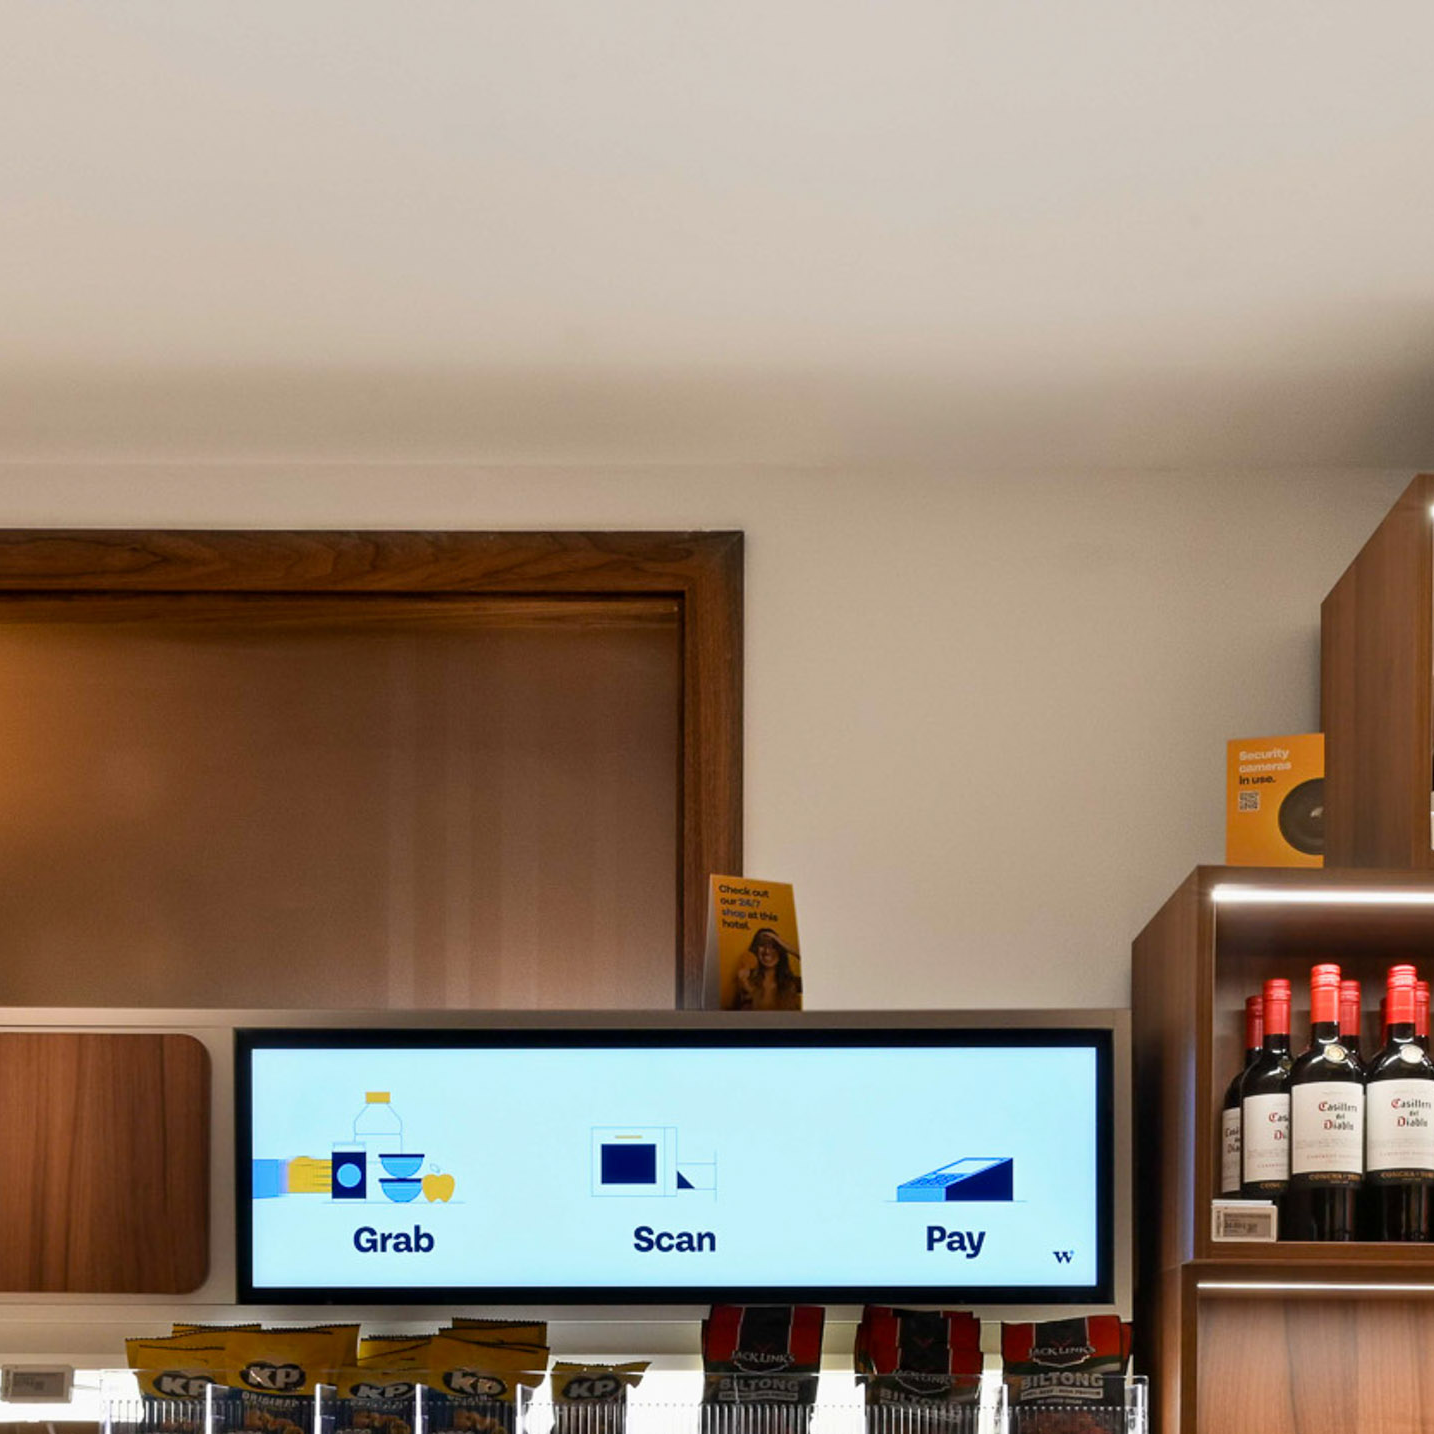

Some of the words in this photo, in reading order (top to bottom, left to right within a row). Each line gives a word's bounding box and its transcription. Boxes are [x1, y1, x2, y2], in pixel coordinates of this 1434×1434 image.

[1239, 748, 1289, 761] Security
[1239, 762, 1292, 772] cameras
[1252, 775, 1276, 784] use.
[719, 884, 751, 895] Check
[752, 890, 769, 898] out
[353, 1224, 435, 1255] Grab
[633, 1225, 716, 1254] Scan
[926, 1225, 986, 1261] Pay
[245, 1365, 305, 1389] KP
[1020, 1372, 1105, 1389] BILTONG
[718, 1378, 799, 1393] BILTONG
